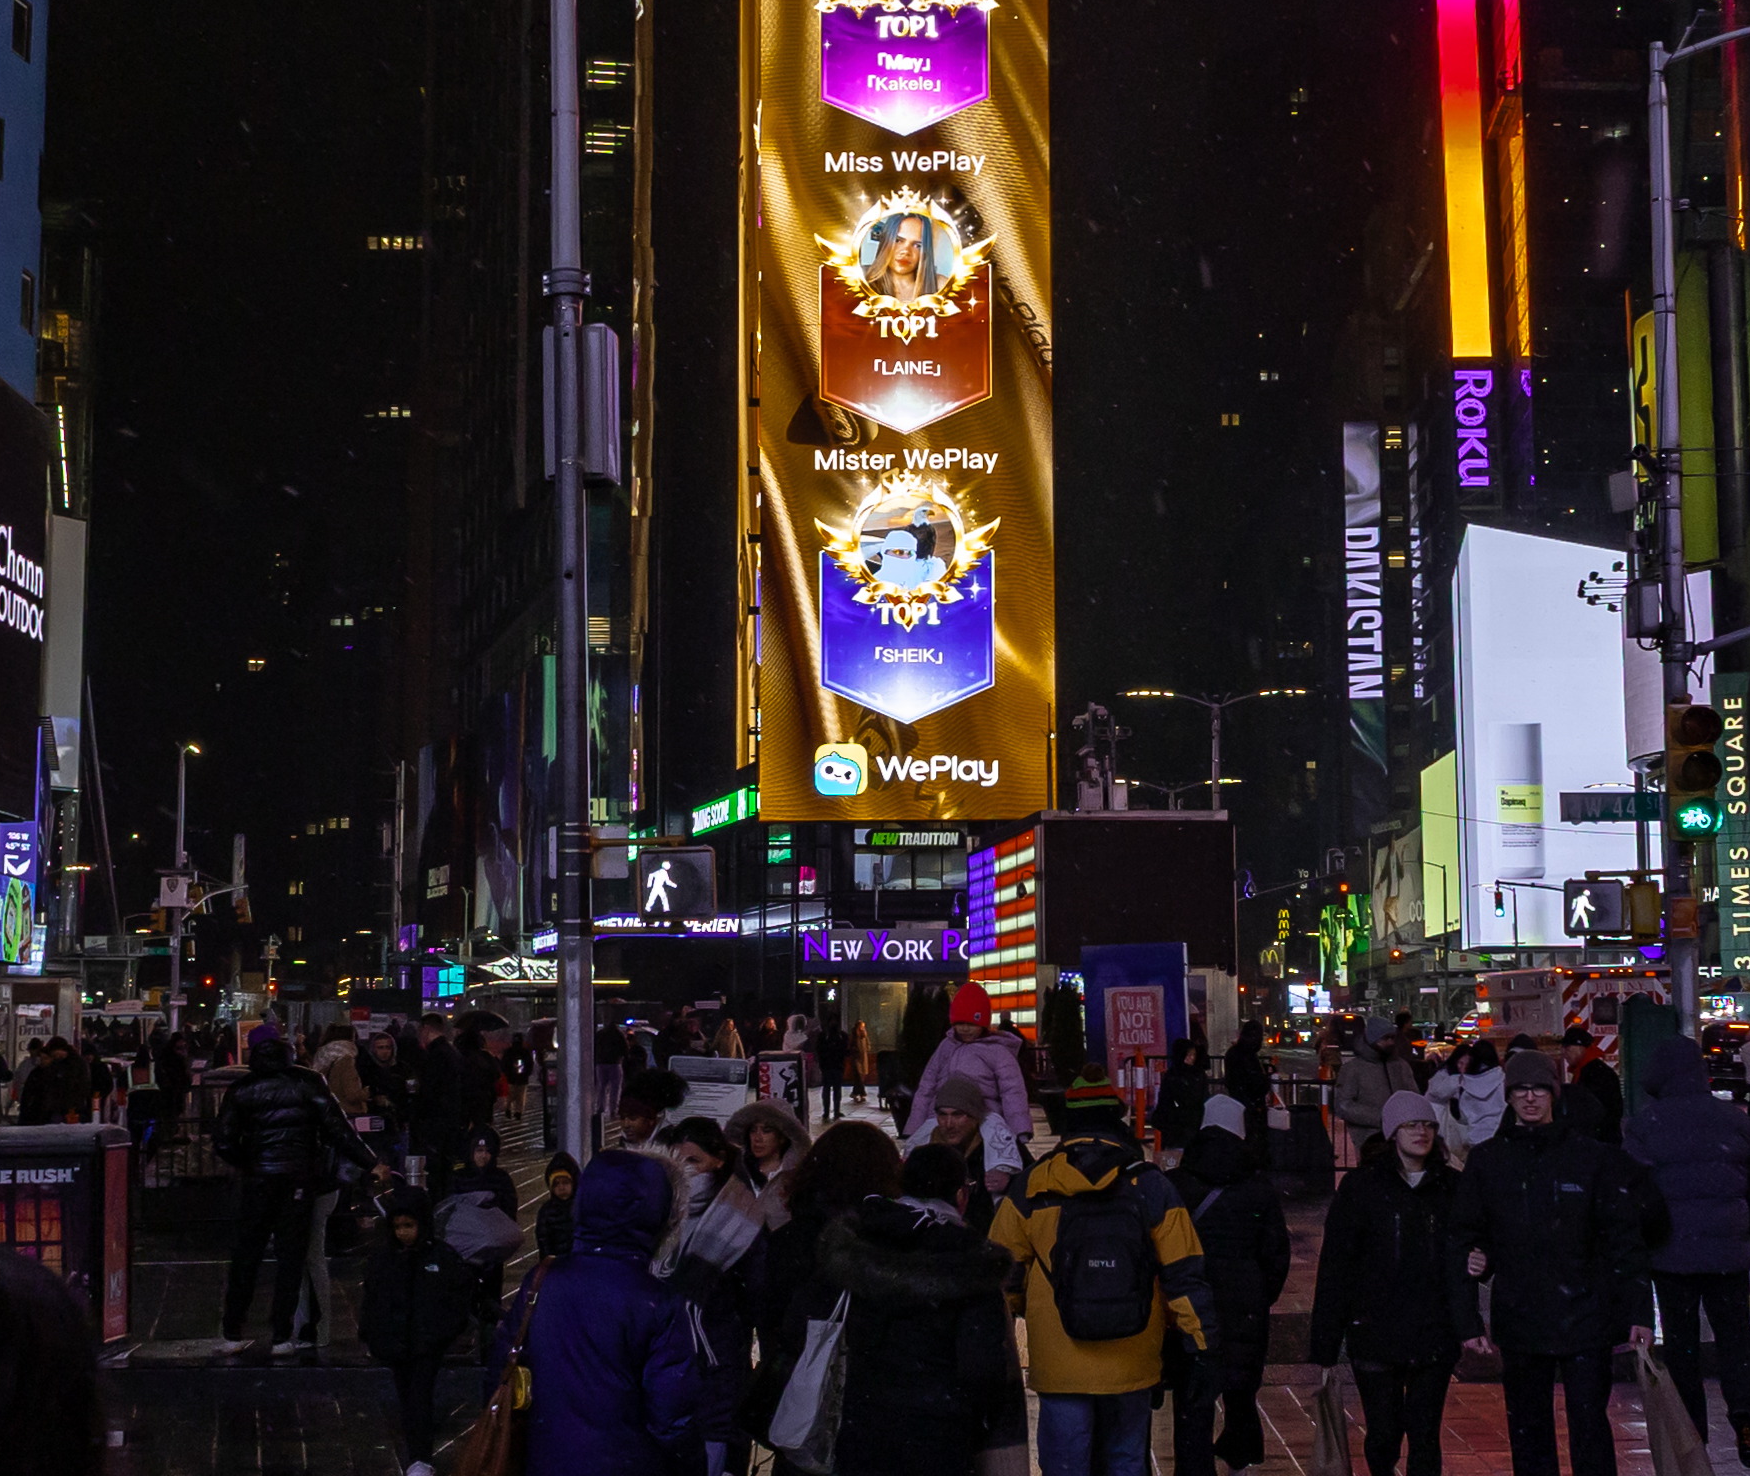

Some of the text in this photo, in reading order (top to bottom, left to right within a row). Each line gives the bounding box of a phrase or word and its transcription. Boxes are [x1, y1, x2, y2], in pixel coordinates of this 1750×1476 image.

[824, 150, 986, 176] Miss WePlay
[813, 447, 999, 474] Mister WePlay
[1723, 695, 1748, 815] SQUARE
[876, 754, 1000, 787] WePlay
[803, 931, 864, 962] NEW
[867, 930, 934, 962] YORK
[1117, 995, 1134, 1011] YOU
[1118, 1012, 1155, 1030] NOT
[1118, 1029, 1155, 1045] ALONE
